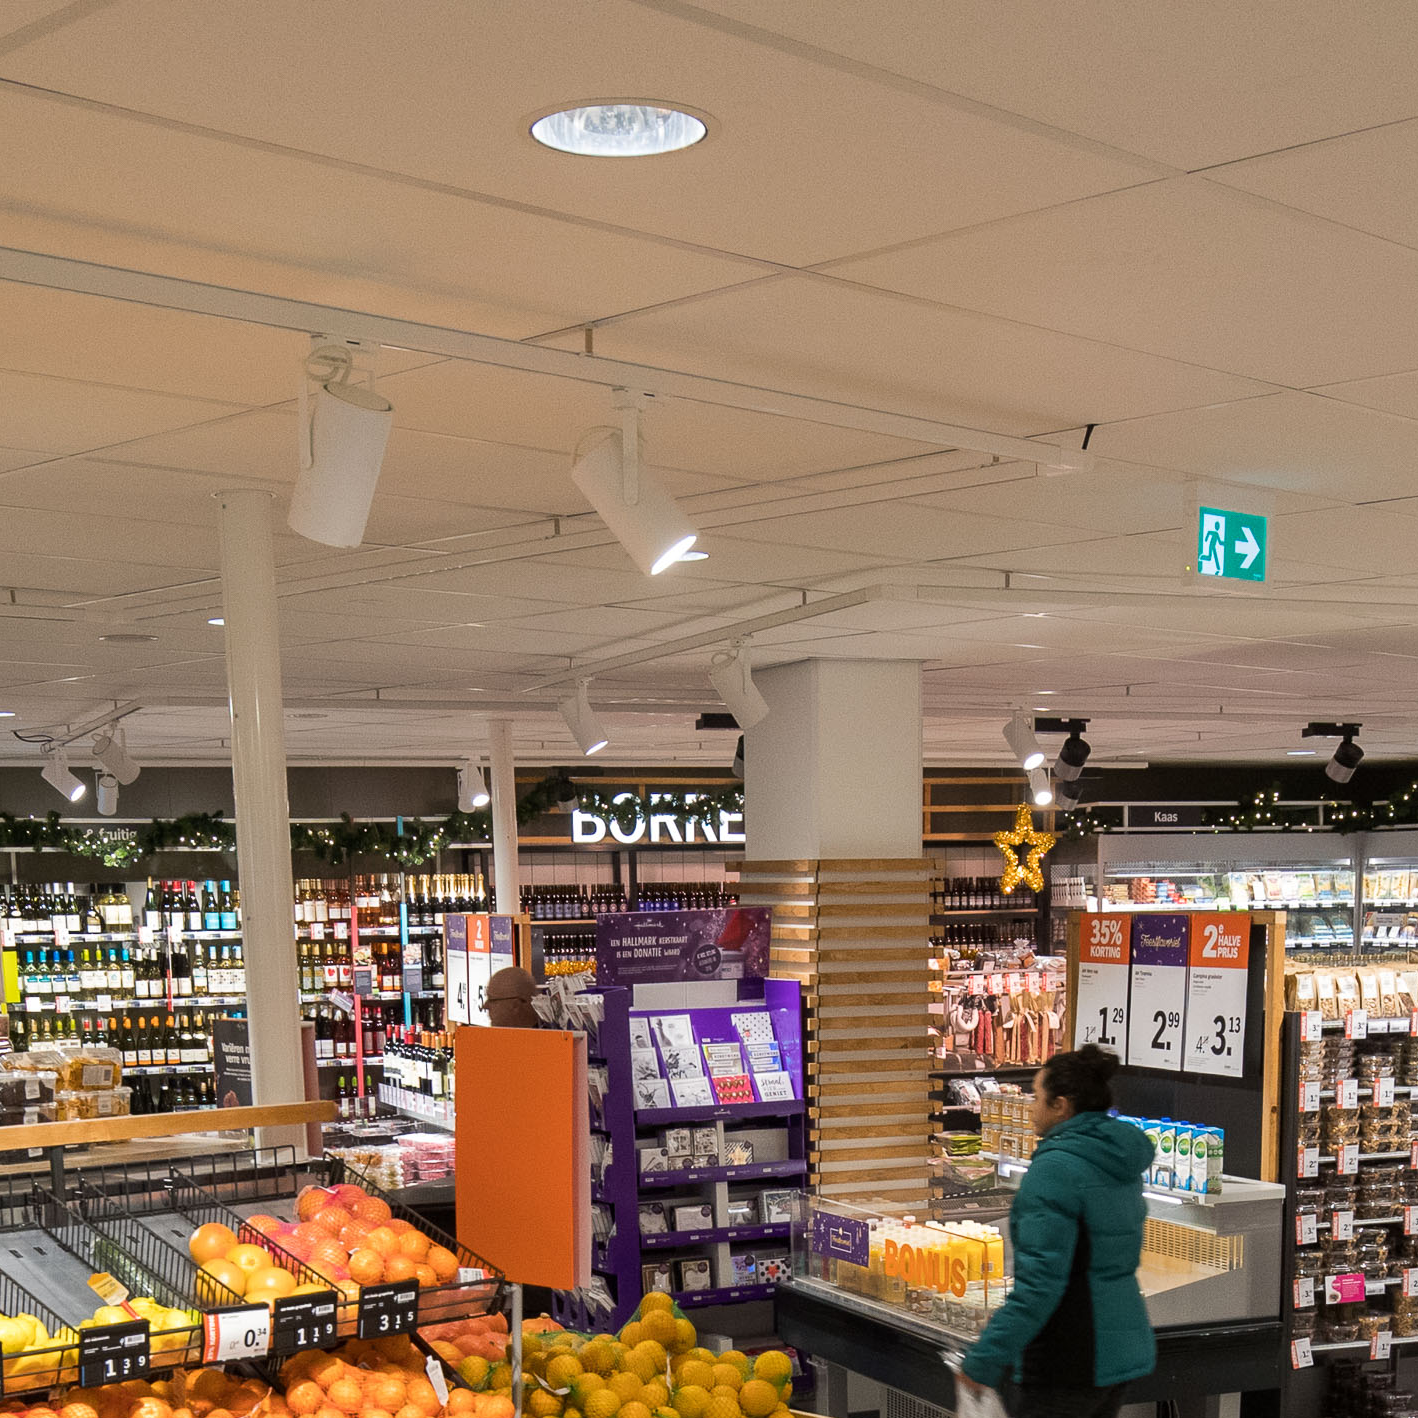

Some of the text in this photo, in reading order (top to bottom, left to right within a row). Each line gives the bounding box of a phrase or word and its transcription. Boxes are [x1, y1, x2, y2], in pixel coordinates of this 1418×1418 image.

[1154, 811, 1178, 822] Kaas
[1090, 919, 1123, 945] 35%
[622, 936, 657, 948] HALLMARK
[1218, 935, 1242, 947] HALVE
[633, 947, 662, 958] DONATIE
[1090, 946, 1122, 959] KORTING
[1217, 947, 1239, 959] PRIJS
[1151, 1010, 1180, 1051] 2.99
[1210, 1015, 1241, 1057] 3.13
[885, 1238, 967, 1298] BONUS
[243, 1327, 267, 1348] 0.34
